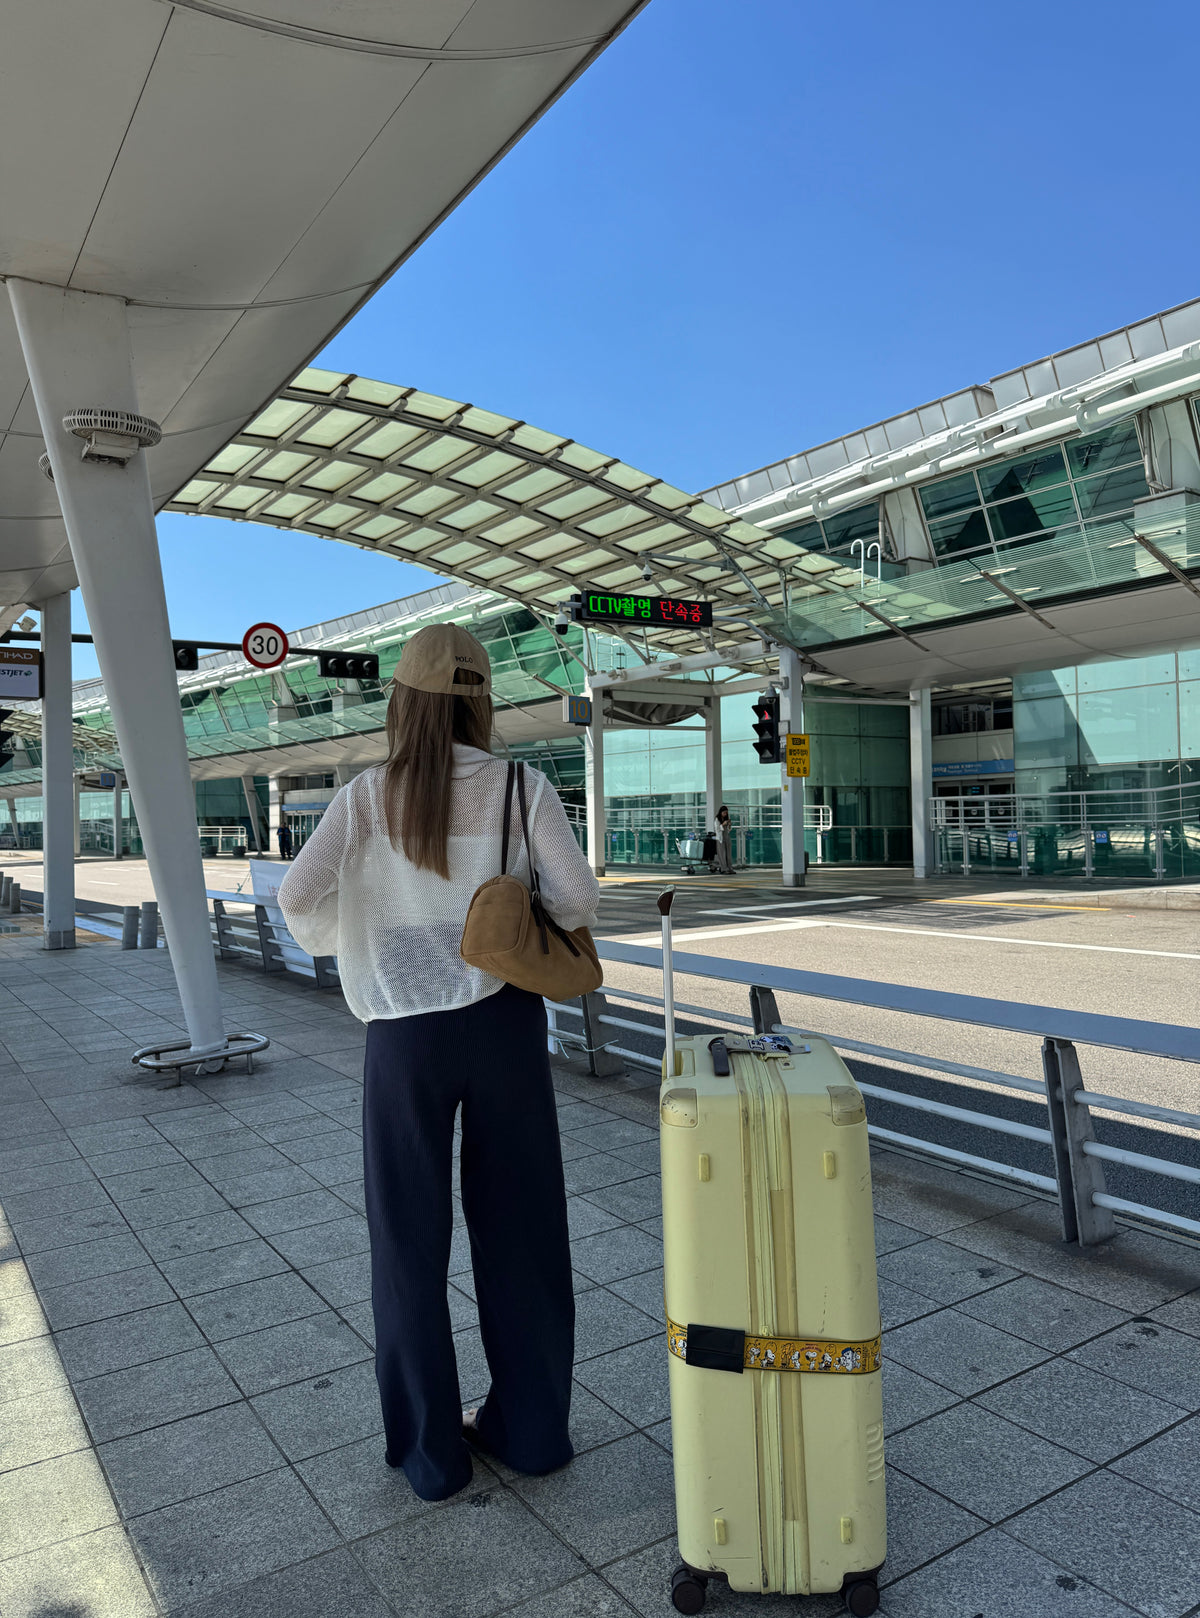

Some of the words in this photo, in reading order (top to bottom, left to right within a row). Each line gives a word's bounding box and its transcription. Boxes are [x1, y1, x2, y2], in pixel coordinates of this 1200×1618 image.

[589, 595, 651, 618] CCTV촬영
[660, 600, 702, 622] 단속중
[252, 635, 278, 655] 30
[570, 700, 588, 719] 10
